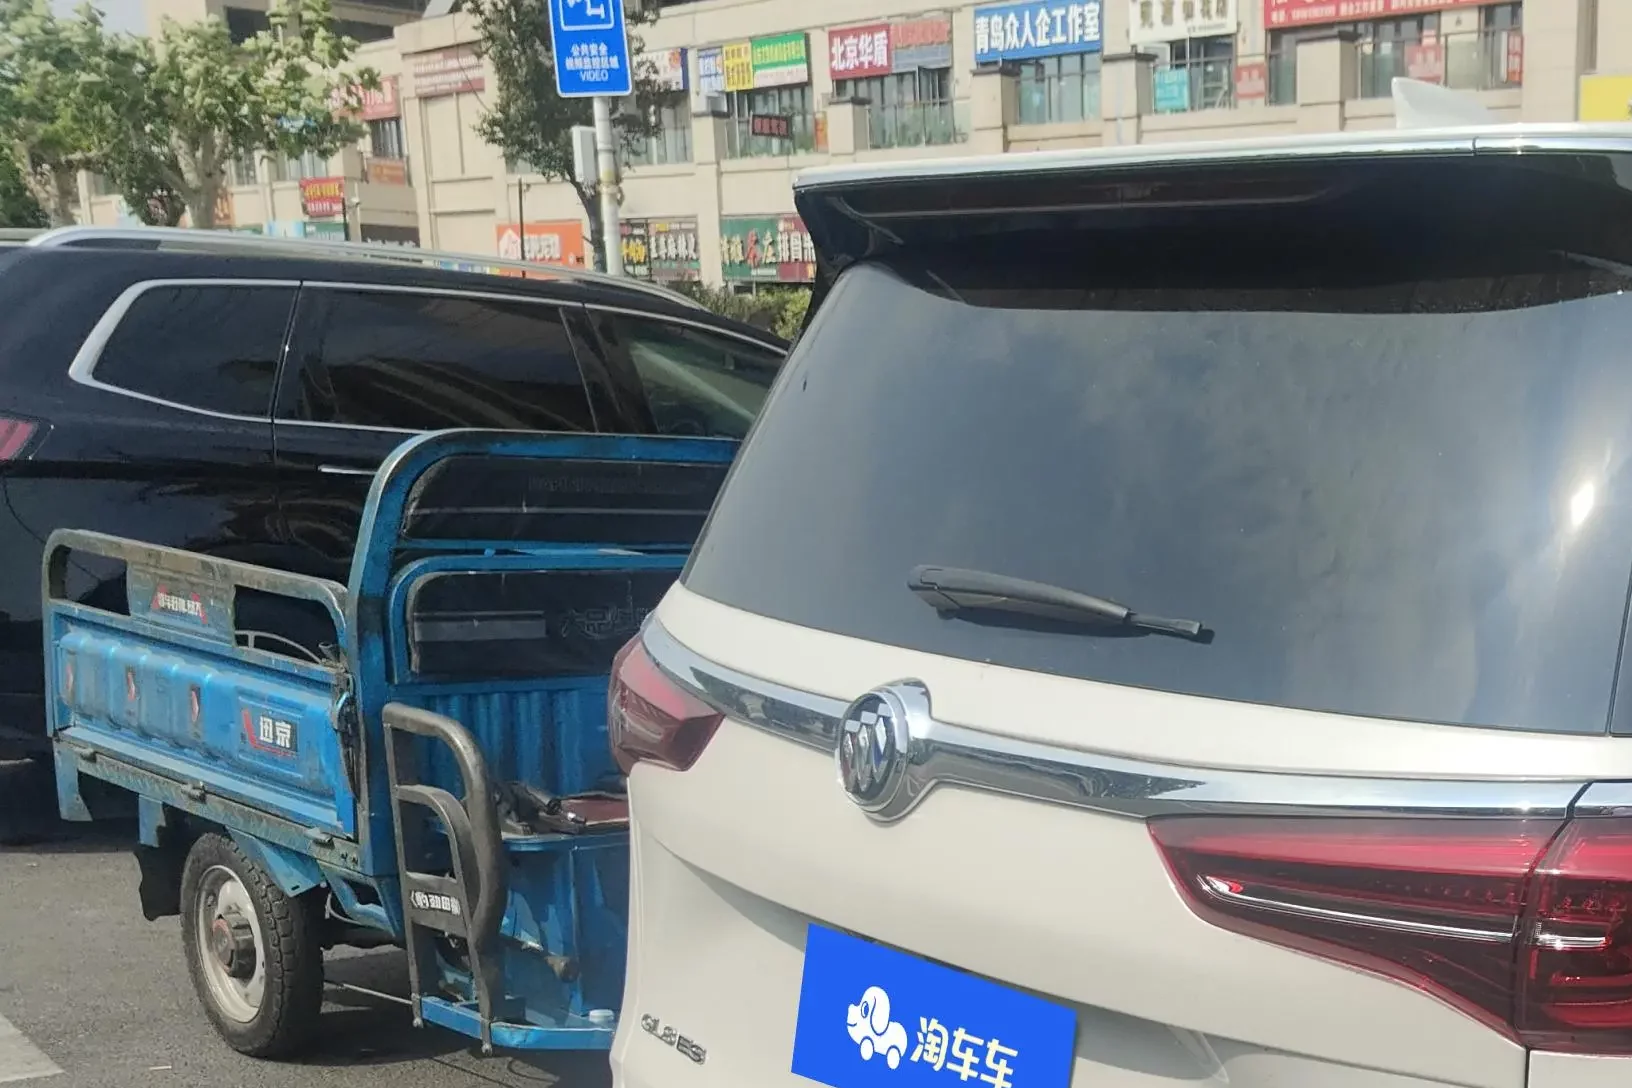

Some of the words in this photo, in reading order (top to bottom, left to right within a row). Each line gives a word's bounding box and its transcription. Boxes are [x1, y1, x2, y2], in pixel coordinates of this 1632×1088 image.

[975, 2, 1100, 54] 青岛众人企工作室
[571, 42, 608, 57] 公共安全
[831, 31, 888, 72] 北京华盾
[580, 69, 609, 81] VIDEO
